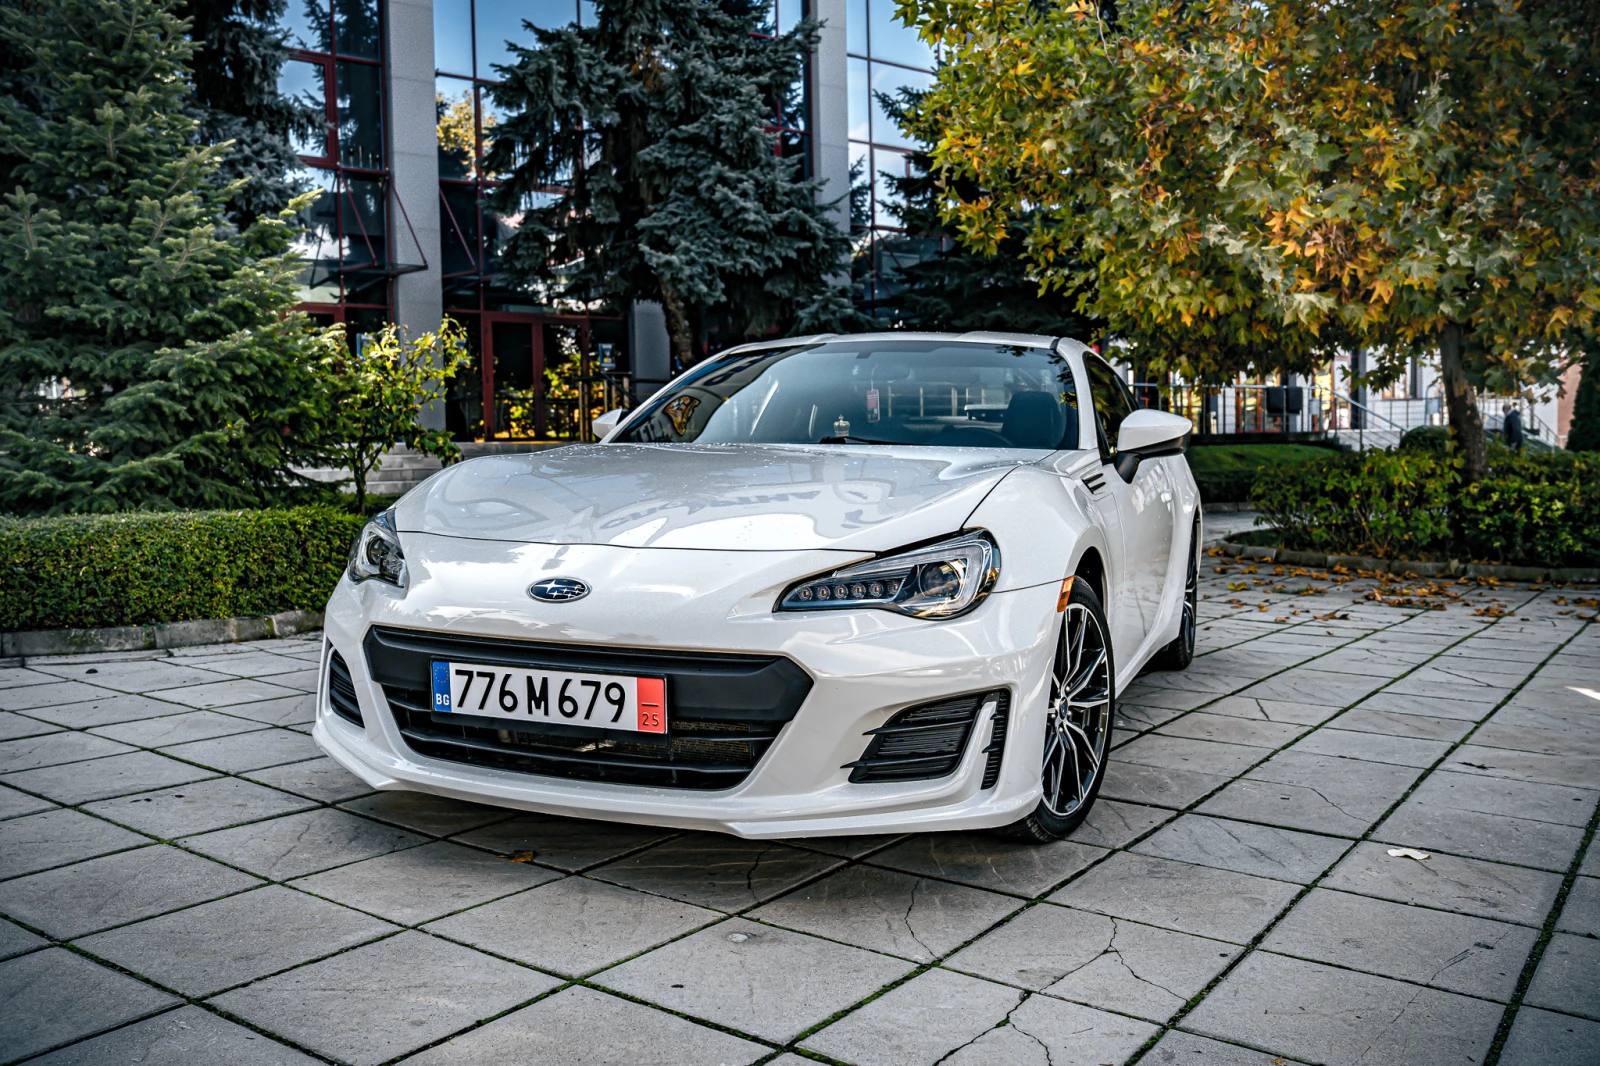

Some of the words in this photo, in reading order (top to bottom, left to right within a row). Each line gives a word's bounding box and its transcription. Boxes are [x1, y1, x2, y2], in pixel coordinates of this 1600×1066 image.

[435, 692, 450, 706] BG
[455, 669, 518, 712] 776
[526, 675, 549, 717] M
[558, 678, 625, 723] 679
[642, 712, 660, 727] 25
